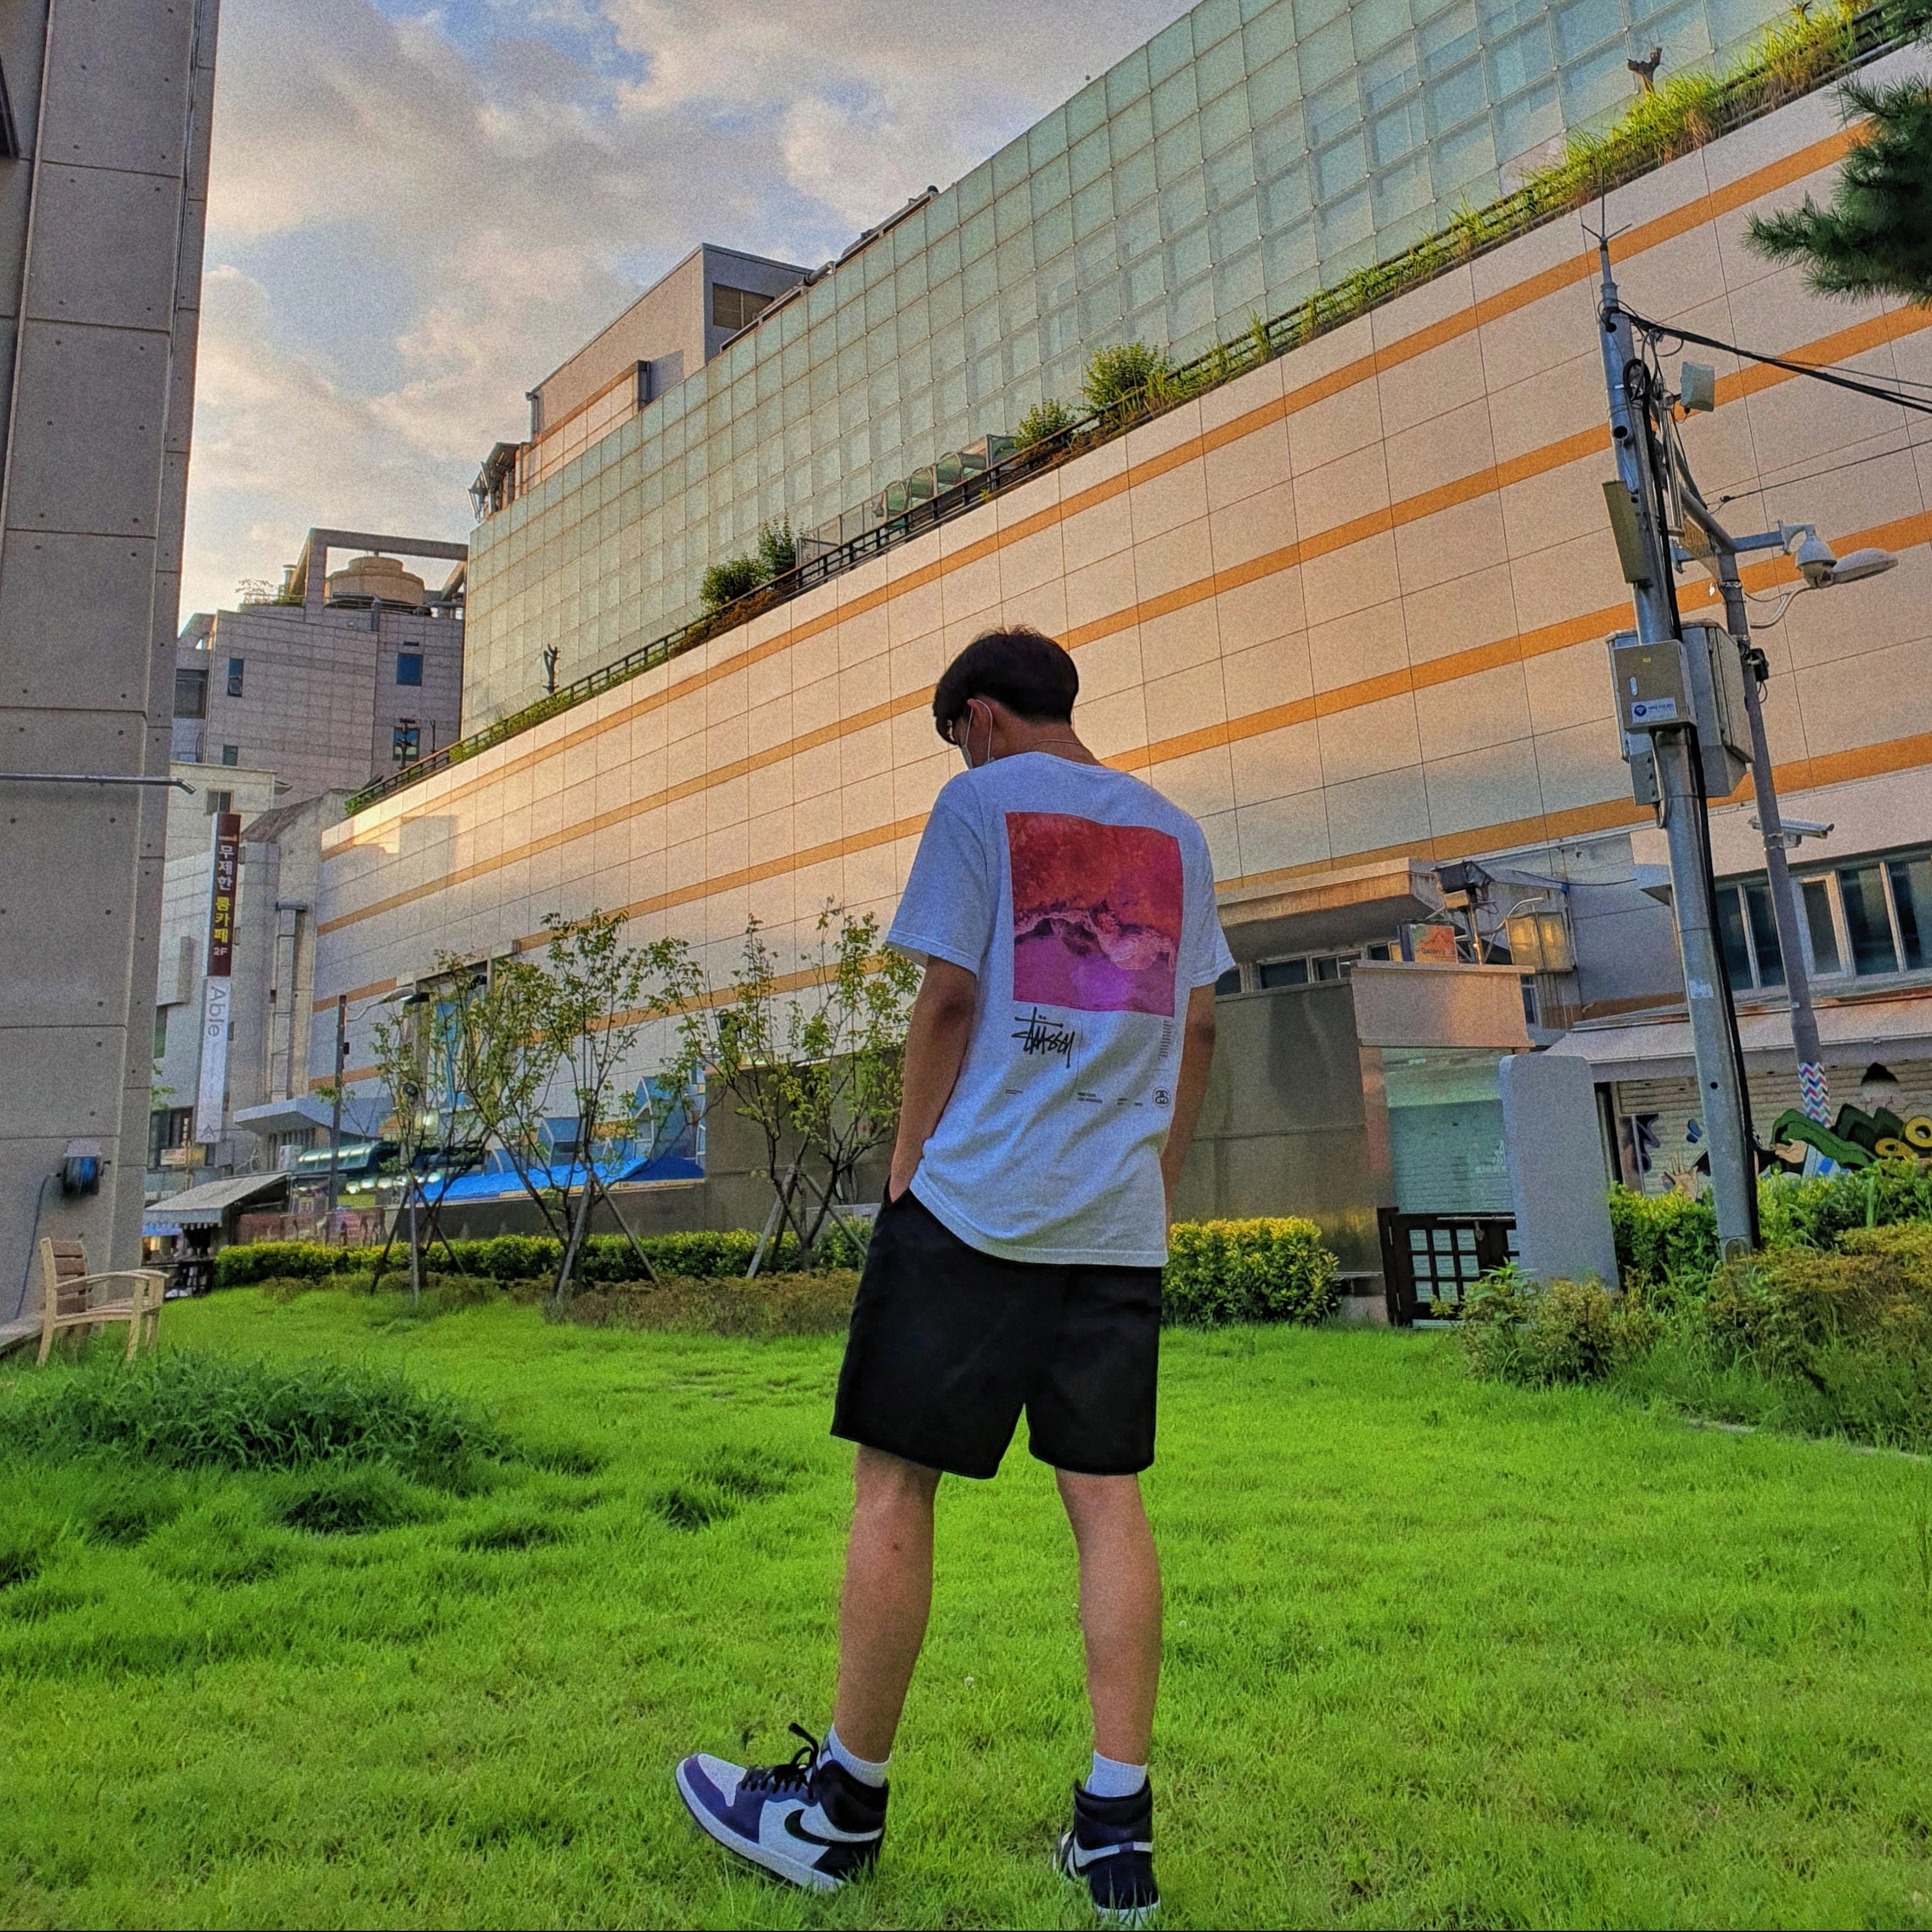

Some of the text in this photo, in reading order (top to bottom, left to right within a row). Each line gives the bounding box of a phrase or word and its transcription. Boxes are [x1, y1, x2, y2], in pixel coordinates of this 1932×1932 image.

[217, 845, 234, 891] 무제한
[213, 947, 228, 956] 2F
[208, 985, 226, 1037] Able
